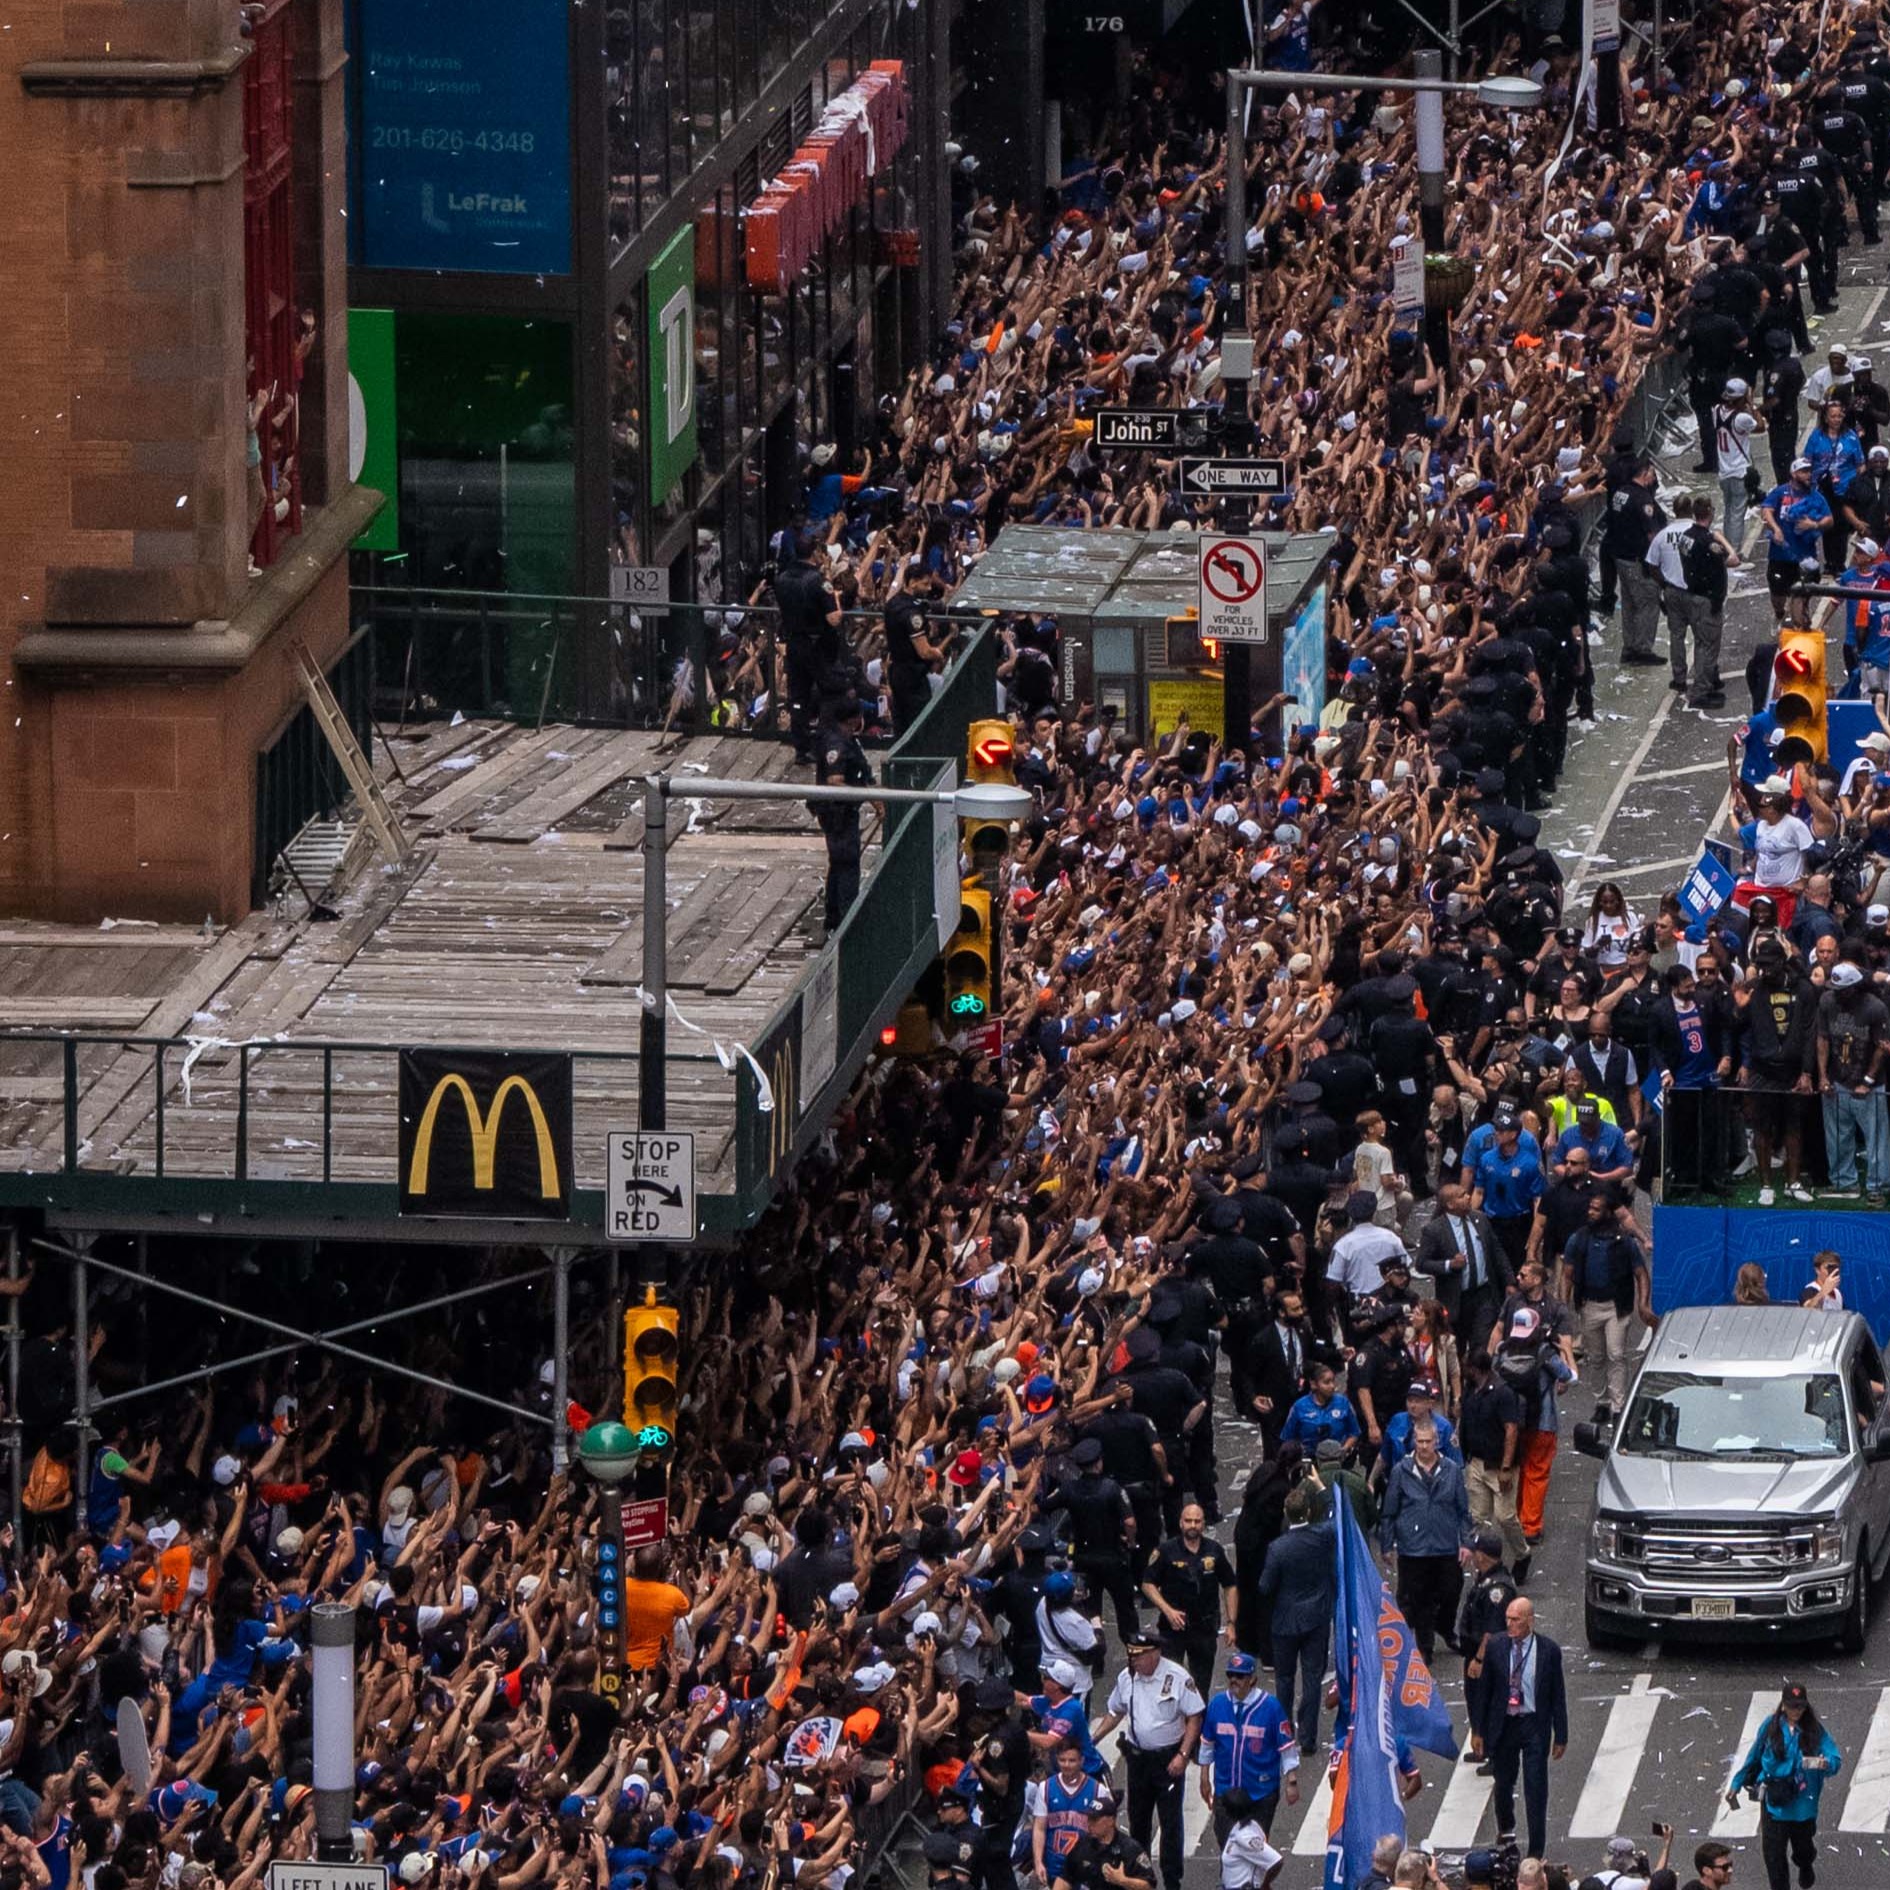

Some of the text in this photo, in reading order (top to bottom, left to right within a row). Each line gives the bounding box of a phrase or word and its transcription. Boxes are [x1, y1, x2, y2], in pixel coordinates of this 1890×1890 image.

[1084, 16, 1124, 33] 176
[373, 127, 535, 154] 201-626-4348
[448, 192, 528, 214] LeFrak
[1105, 420, 1169, 441] John ST
[1197, 470, 1271, 485] ONE WAY
[624, 571, 660, 592] 182
[1224, 605, 1241, 615] FOR
[1212, 615, 1254, 627] VEHICLES
[1206, 625, 1231, 636] OVER
[1247, 627, 1259, 637] FT
[1064, 637, 1076, 702] Newsstan
[1688, 1031, 1703, 1054] 3
[621, 1140, 681, 1161] STOP
[631, 1165, 670, 1179] HERE
[627, 1195, 646, 1207] ON
[615, 1211, 661, 1231] RED
[621, 1504, 659, 1519] NO STOPPING
[603, 1567, 612, 1580] A
[603, 1590, 615, 1603] C
[603, 1611, 614, 1625] E
[605, 1633, 614, 1646] J
[605, 1654, 615, 1668] Z
[605, 1676, 617, 1690] R
[1054, 1830, 1079, 1855] 17
